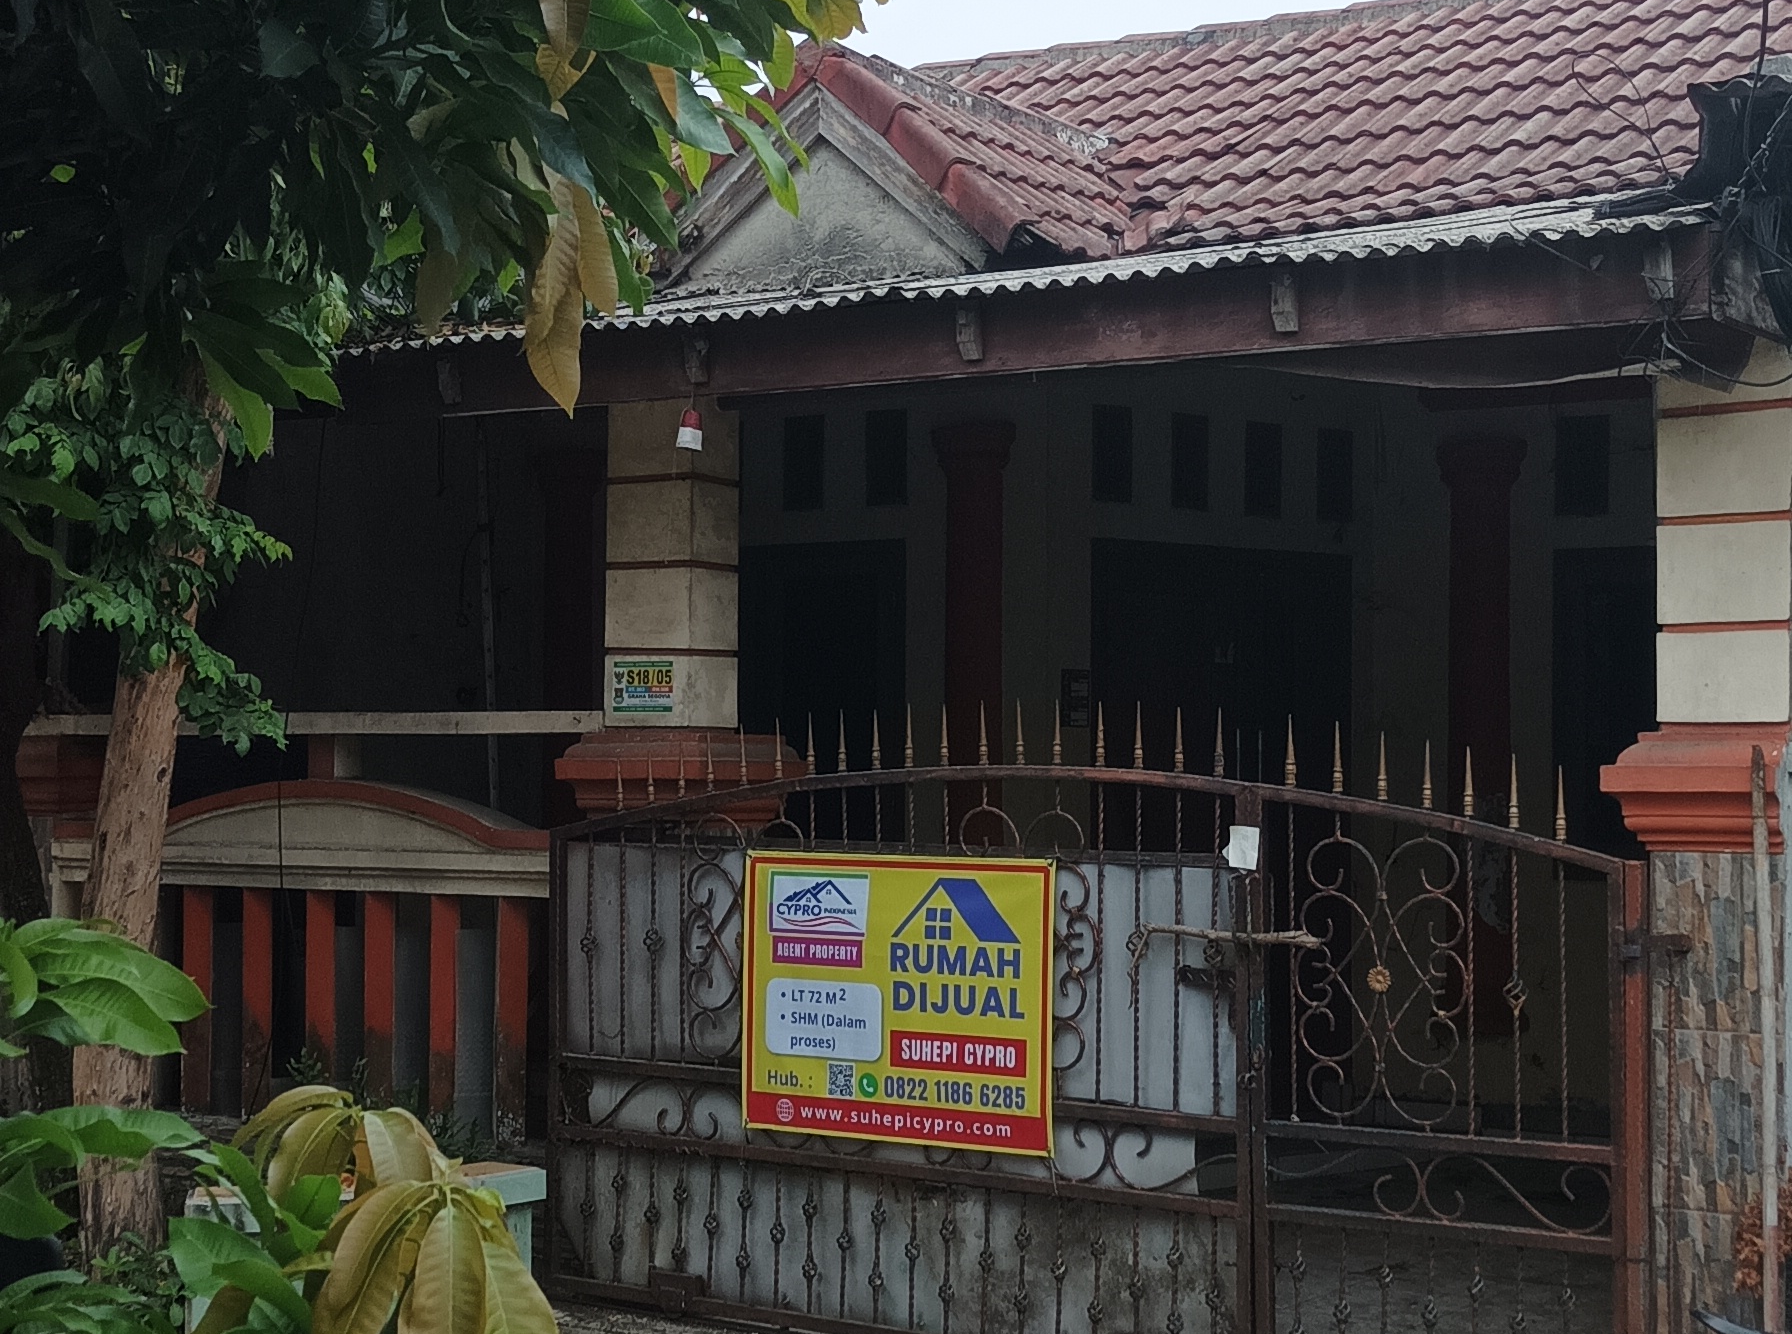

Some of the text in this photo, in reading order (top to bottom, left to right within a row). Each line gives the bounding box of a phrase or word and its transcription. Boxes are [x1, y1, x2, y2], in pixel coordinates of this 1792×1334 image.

[626, 669, 672, 685] S18/05
[776, 903, 857, 916] CYPRO INDONESIA
[777, 942, 858, 960] AGENT PROPERTY
[890, 942, 1021, 979] RUMAH
[791, 989, 805, 1002] LT
[808, 990, 822, 1003] 72
[892, 980, 1026, 1020] DIJUAL
[790, 1011, 867, 1029] SHM (Dalam
[790, 1036, 836, 1051] proses)
[901, 1038, 1016, 1069] SUHEPI CYPRO
[767, 1069, 803, 1088] Hub.
[884, 1075, 1026, 1111] 0822 1186 6285
[800, 1105, 1012, 1138] www.suhepicypro.com
